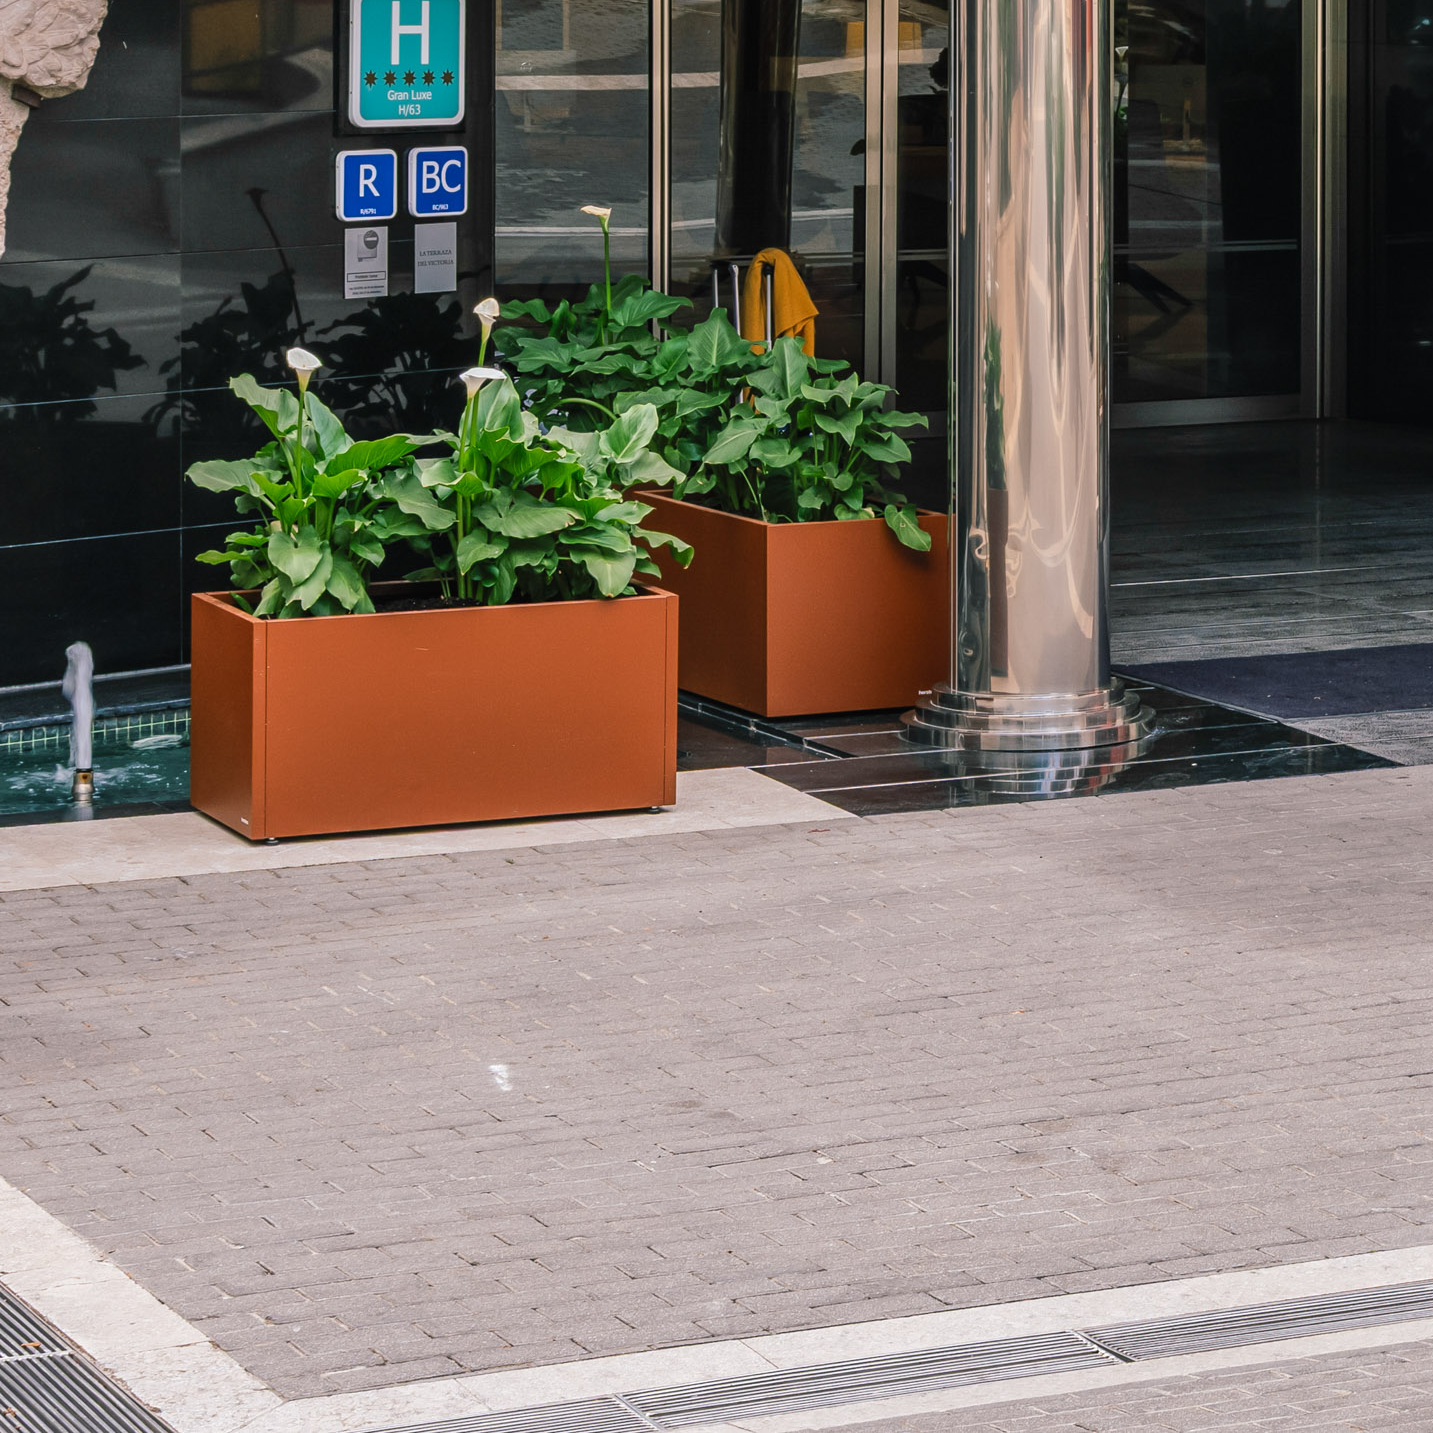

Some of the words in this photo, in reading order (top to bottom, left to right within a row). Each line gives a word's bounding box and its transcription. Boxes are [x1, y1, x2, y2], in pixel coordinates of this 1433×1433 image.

[390, 0, 430, 65] H
[387, 90, 409, 101] Gran
[411, 90, 433, 101] Luxe
[398, 104, 421, 117] H/63
[358, 164, 380, 197] R
[422, 159, 461, 194] BC
